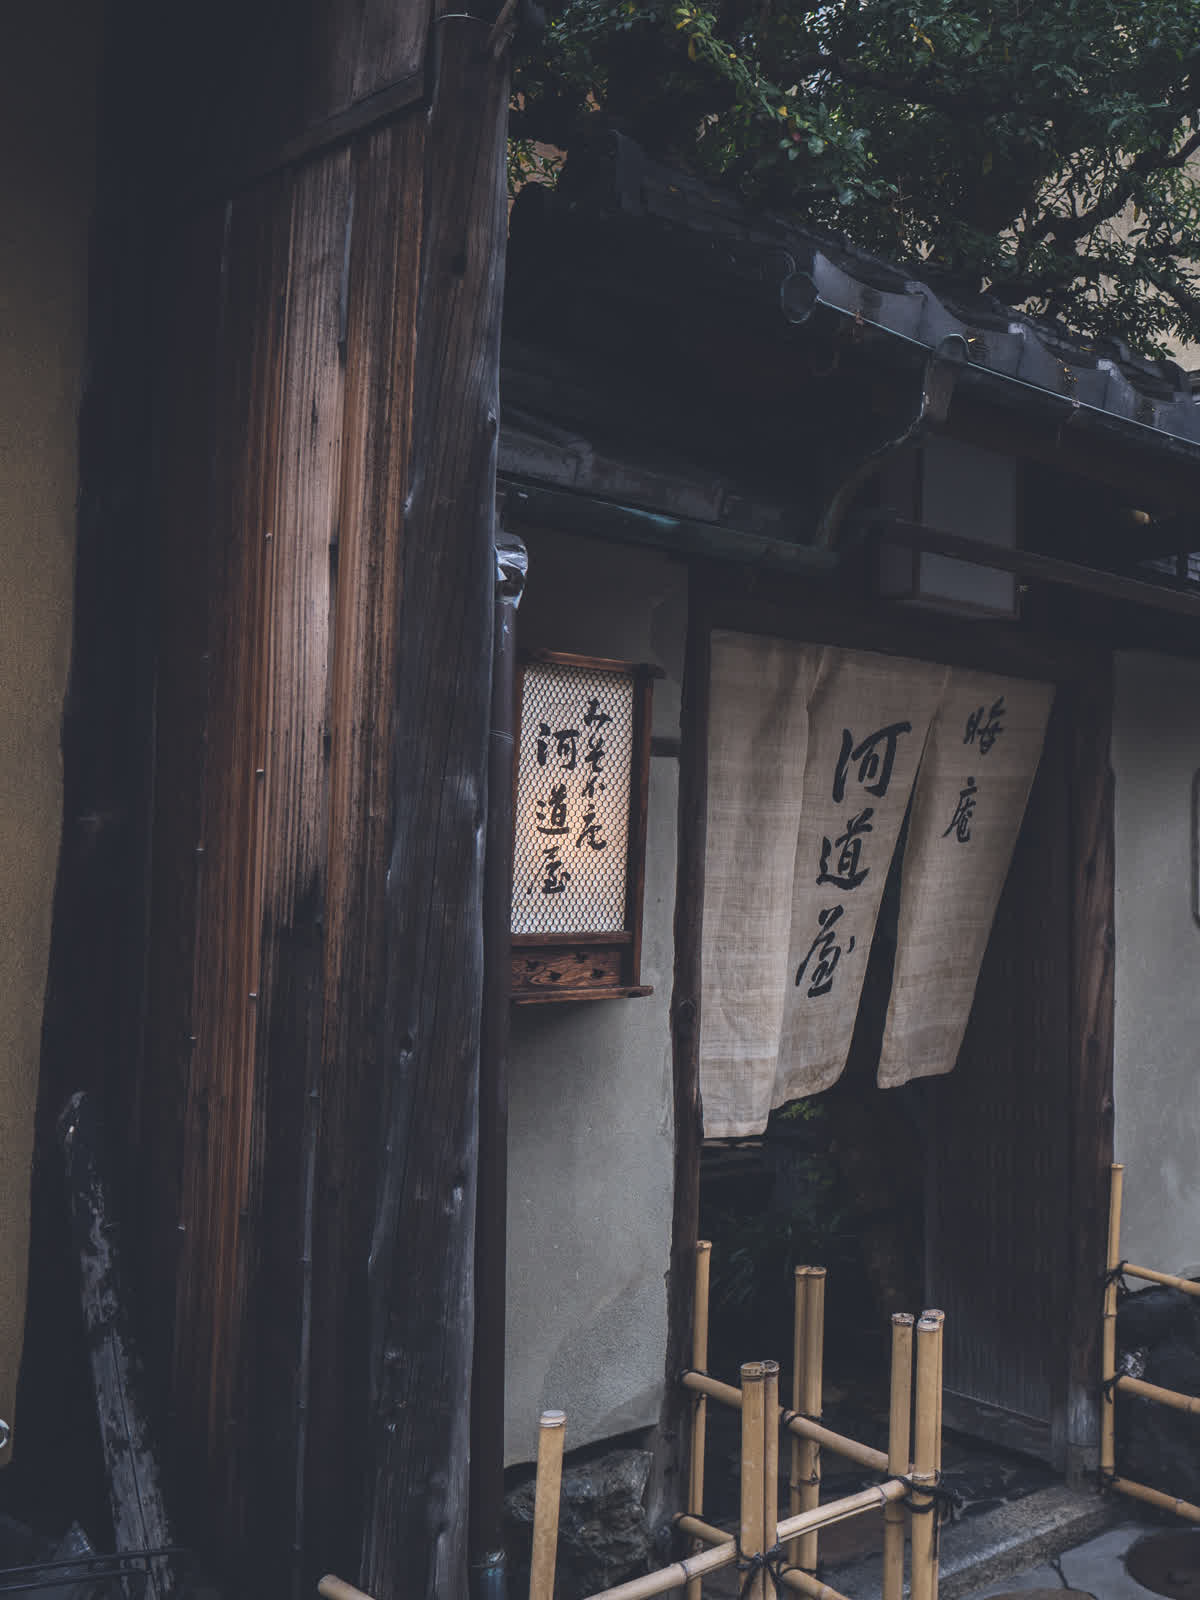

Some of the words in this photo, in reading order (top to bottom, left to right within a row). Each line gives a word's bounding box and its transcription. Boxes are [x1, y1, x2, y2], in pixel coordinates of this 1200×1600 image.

[527, 722, 580, 895] 河道屋
[795, 721, 911, 998] 河道屋
